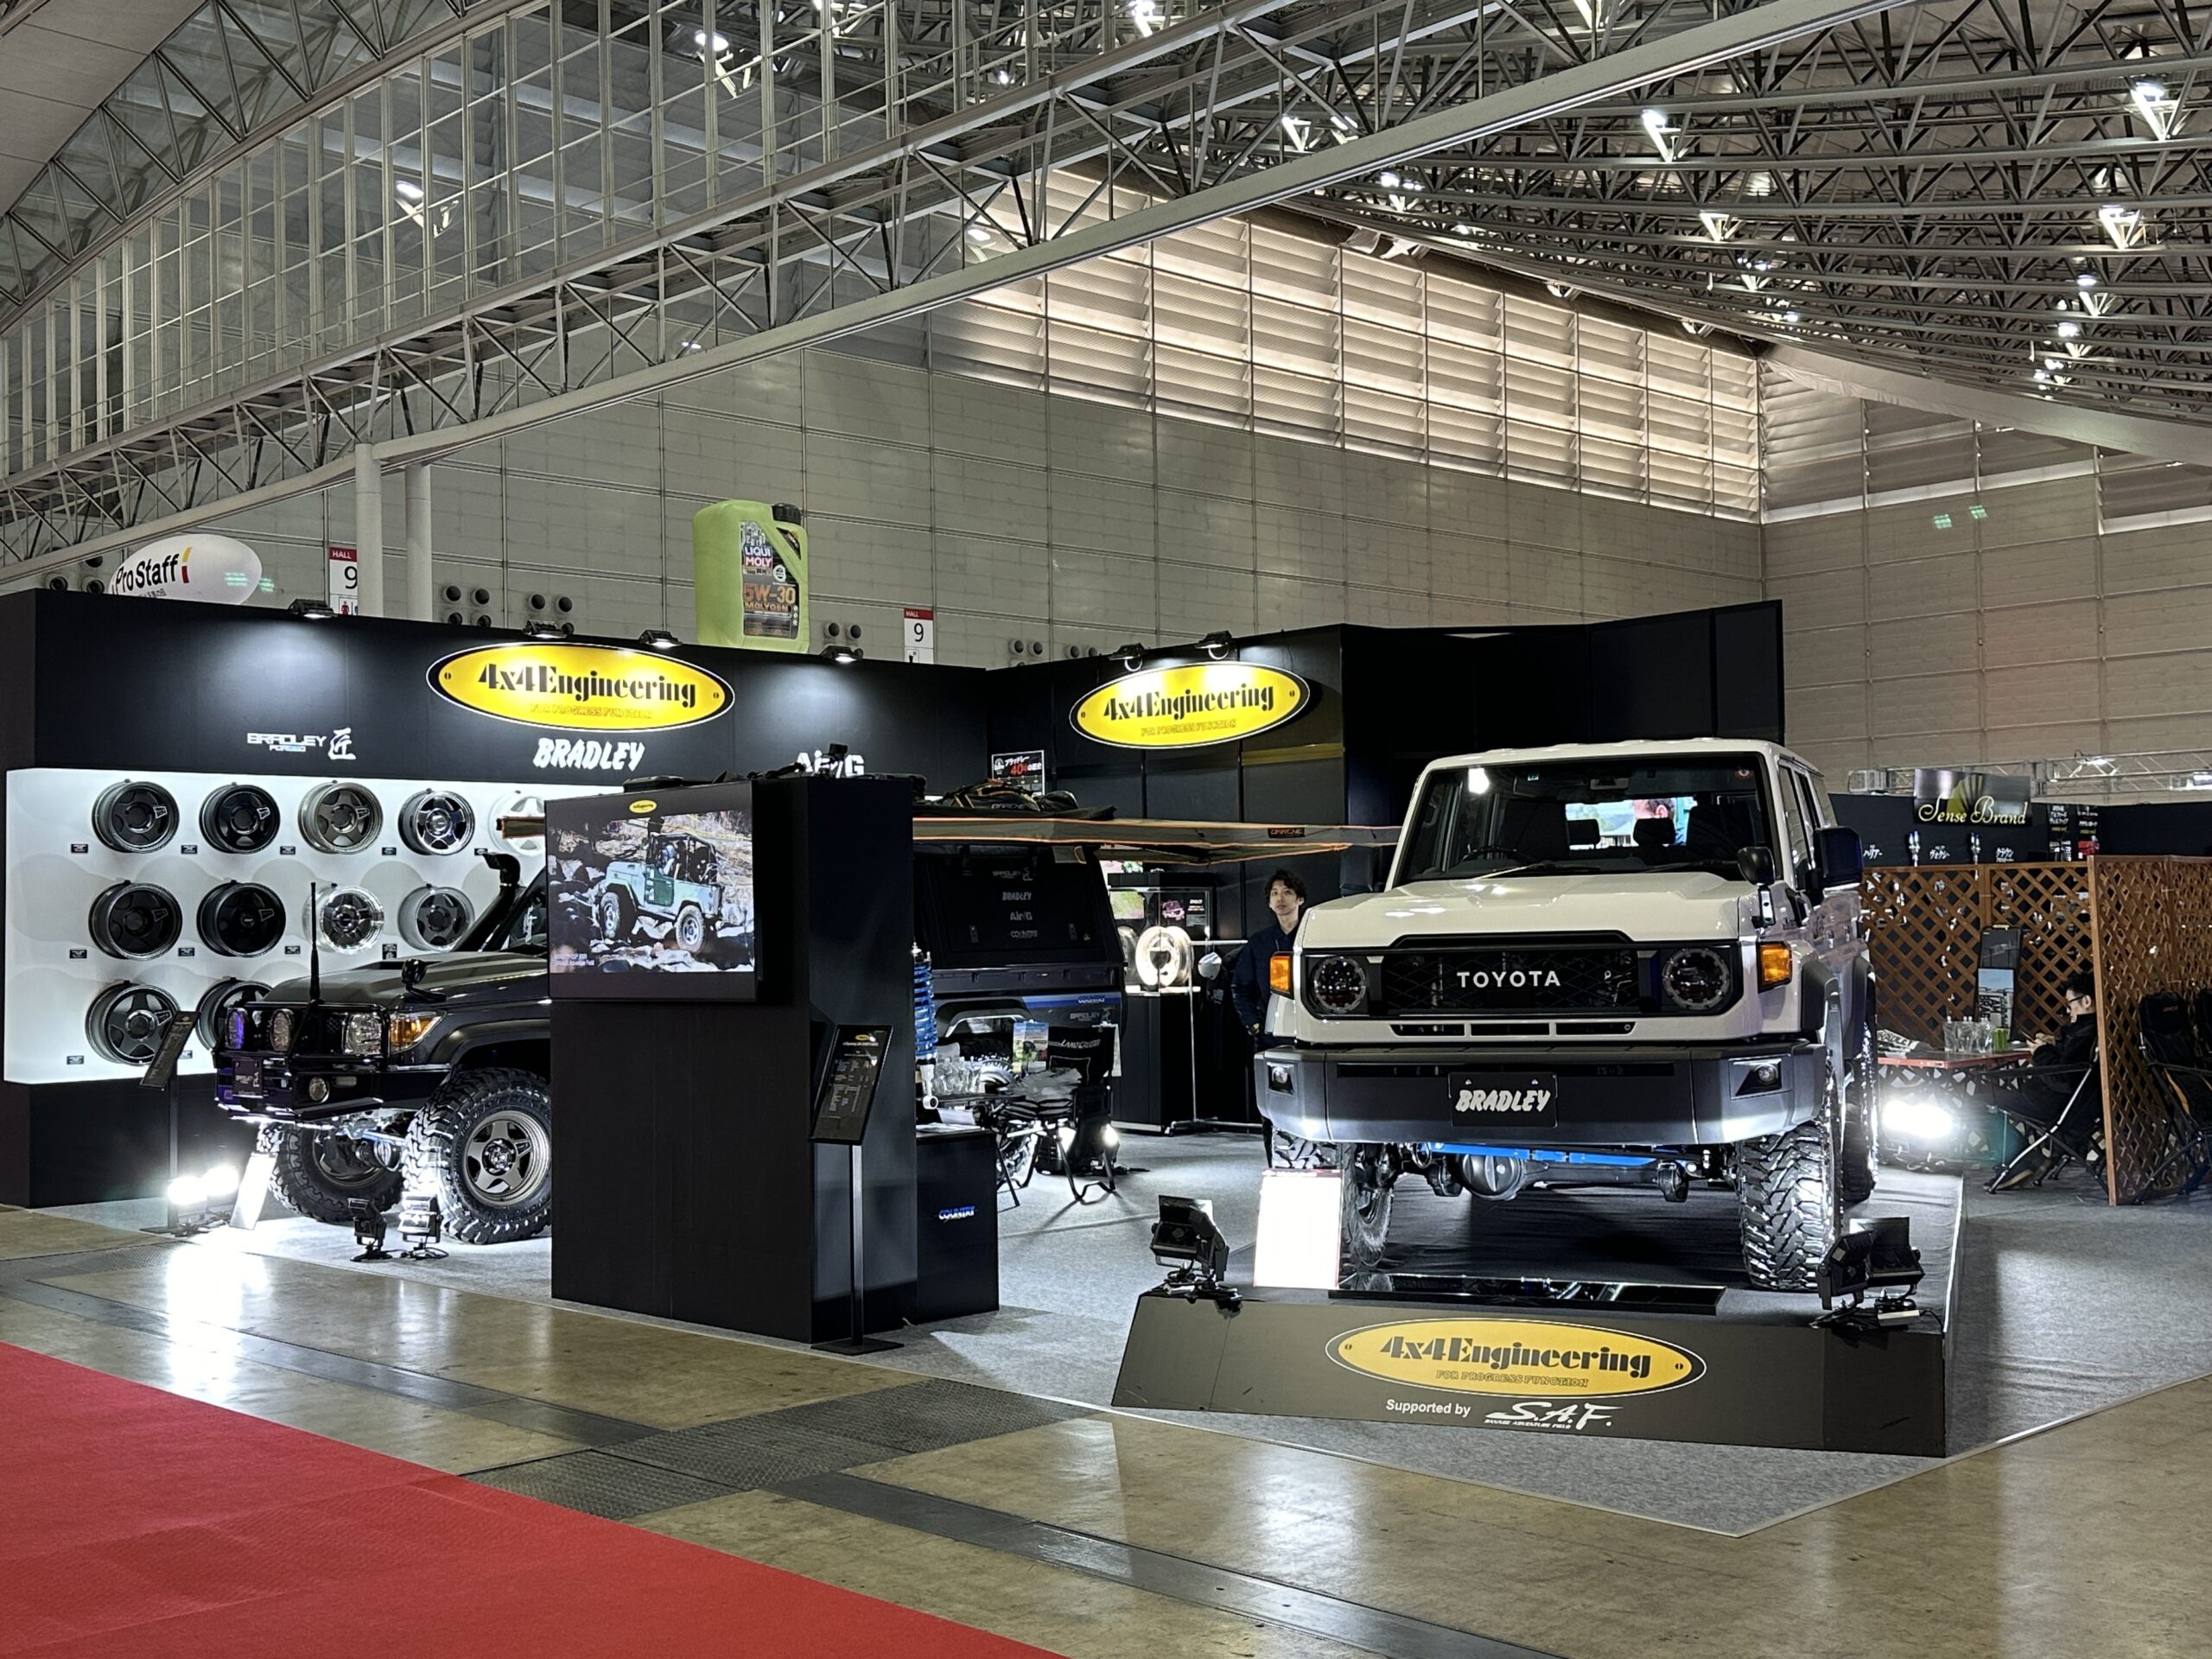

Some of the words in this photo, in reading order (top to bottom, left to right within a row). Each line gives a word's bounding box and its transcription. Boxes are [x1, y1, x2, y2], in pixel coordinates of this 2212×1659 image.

[333, 550, 352, 559] HALL
[745, 546, 771, 556] LIQUI
[746, 557, 772, 568] MOLY
[344, 565, 357, 589] 9
[744, 582, 796, 604] 5W-30
[913, 622, 924, 642] 9
[531, 703, 551, 714] FOR
[1141, 726, 1156, 736] FOR
[247, 733, 327, 747] BRADLEY
[327, 727, 356, 760] 匠
[532, 737, 645, 771] BRADLEY
[1918, 793, 1967, 823] Sense
[1970, 795, 2028, 824] Brand
[1002, 892, 1032, 900] BRADLEY
[1456, 970, 1560, 988] TOYOTA
[1455, 1090, 1551, 1112] BRADLEY
[1380, 1336, 1651, 1378] 4x4Engineering
[1436, 1370, 1459, 1380] FOR
[1460, 1371, 1524, 1384] PROGRESS
[1523, 1375, 1588, 1387] FUNCTION
[1386, 1399, 1455, 1414] Supported
[1454, 1403, 1471, 1418] by
